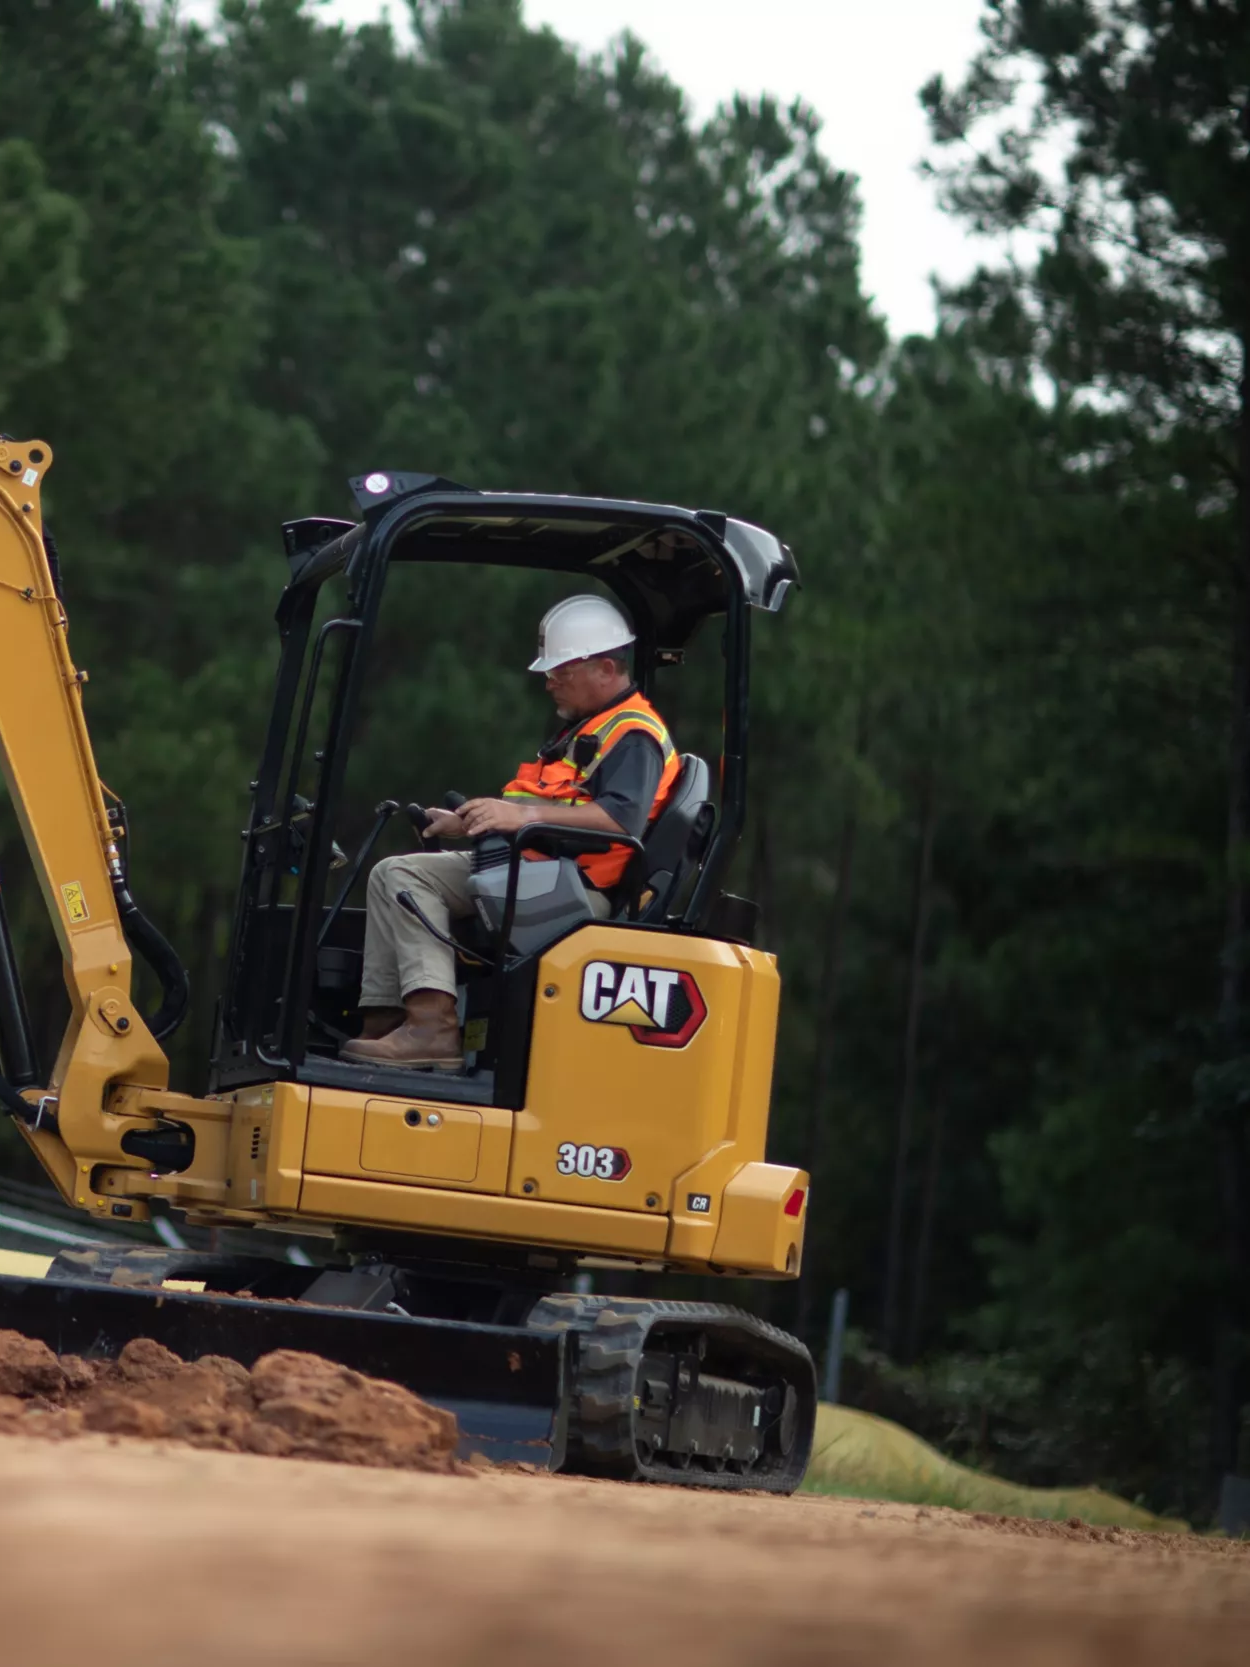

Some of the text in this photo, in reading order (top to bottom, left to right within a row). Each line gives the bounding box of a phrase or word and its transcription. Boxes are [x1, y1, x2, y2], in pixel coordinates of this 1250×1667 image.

[581, 961, 679, 1029] CAT
[557, 1143, 614, 1178] 303
[692, 1196, 707, 1210] CR
